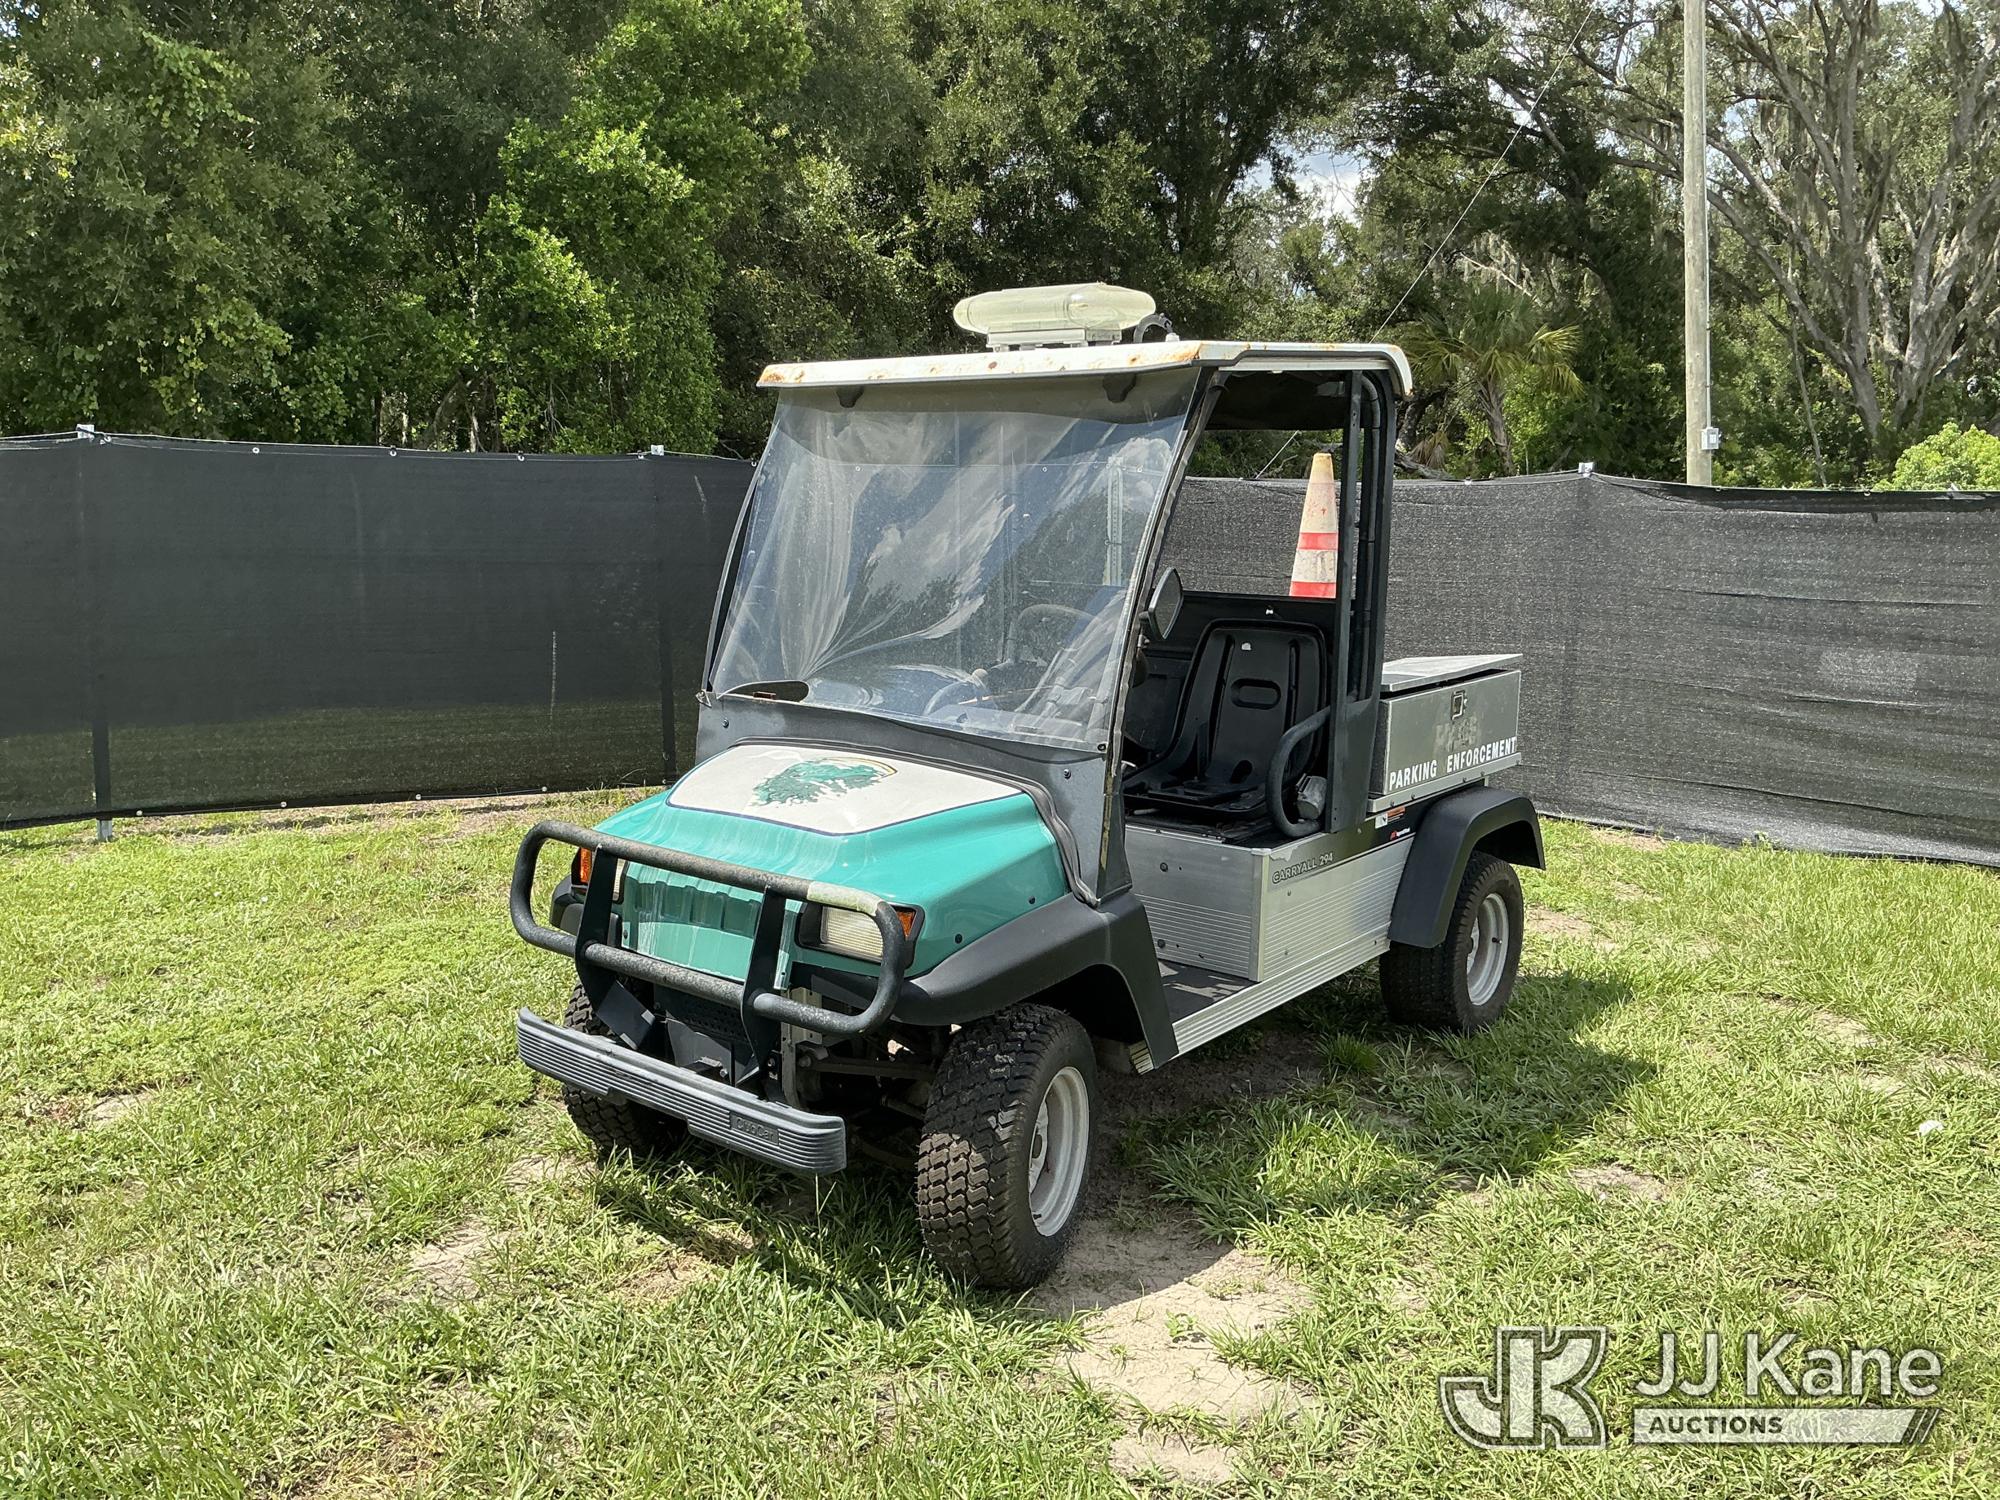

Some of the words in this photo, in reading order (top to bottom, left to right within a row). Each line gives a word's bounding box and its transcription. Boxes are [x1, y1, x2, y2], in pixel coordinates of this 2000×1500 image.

[1389, 760, 1438, 791] PARKING
[1446, 736, 1517, 774] ENFORCEMENT
[1272, 857, 1317, 884] CARRYALL
[1319, 850, 1335, 867] 294
